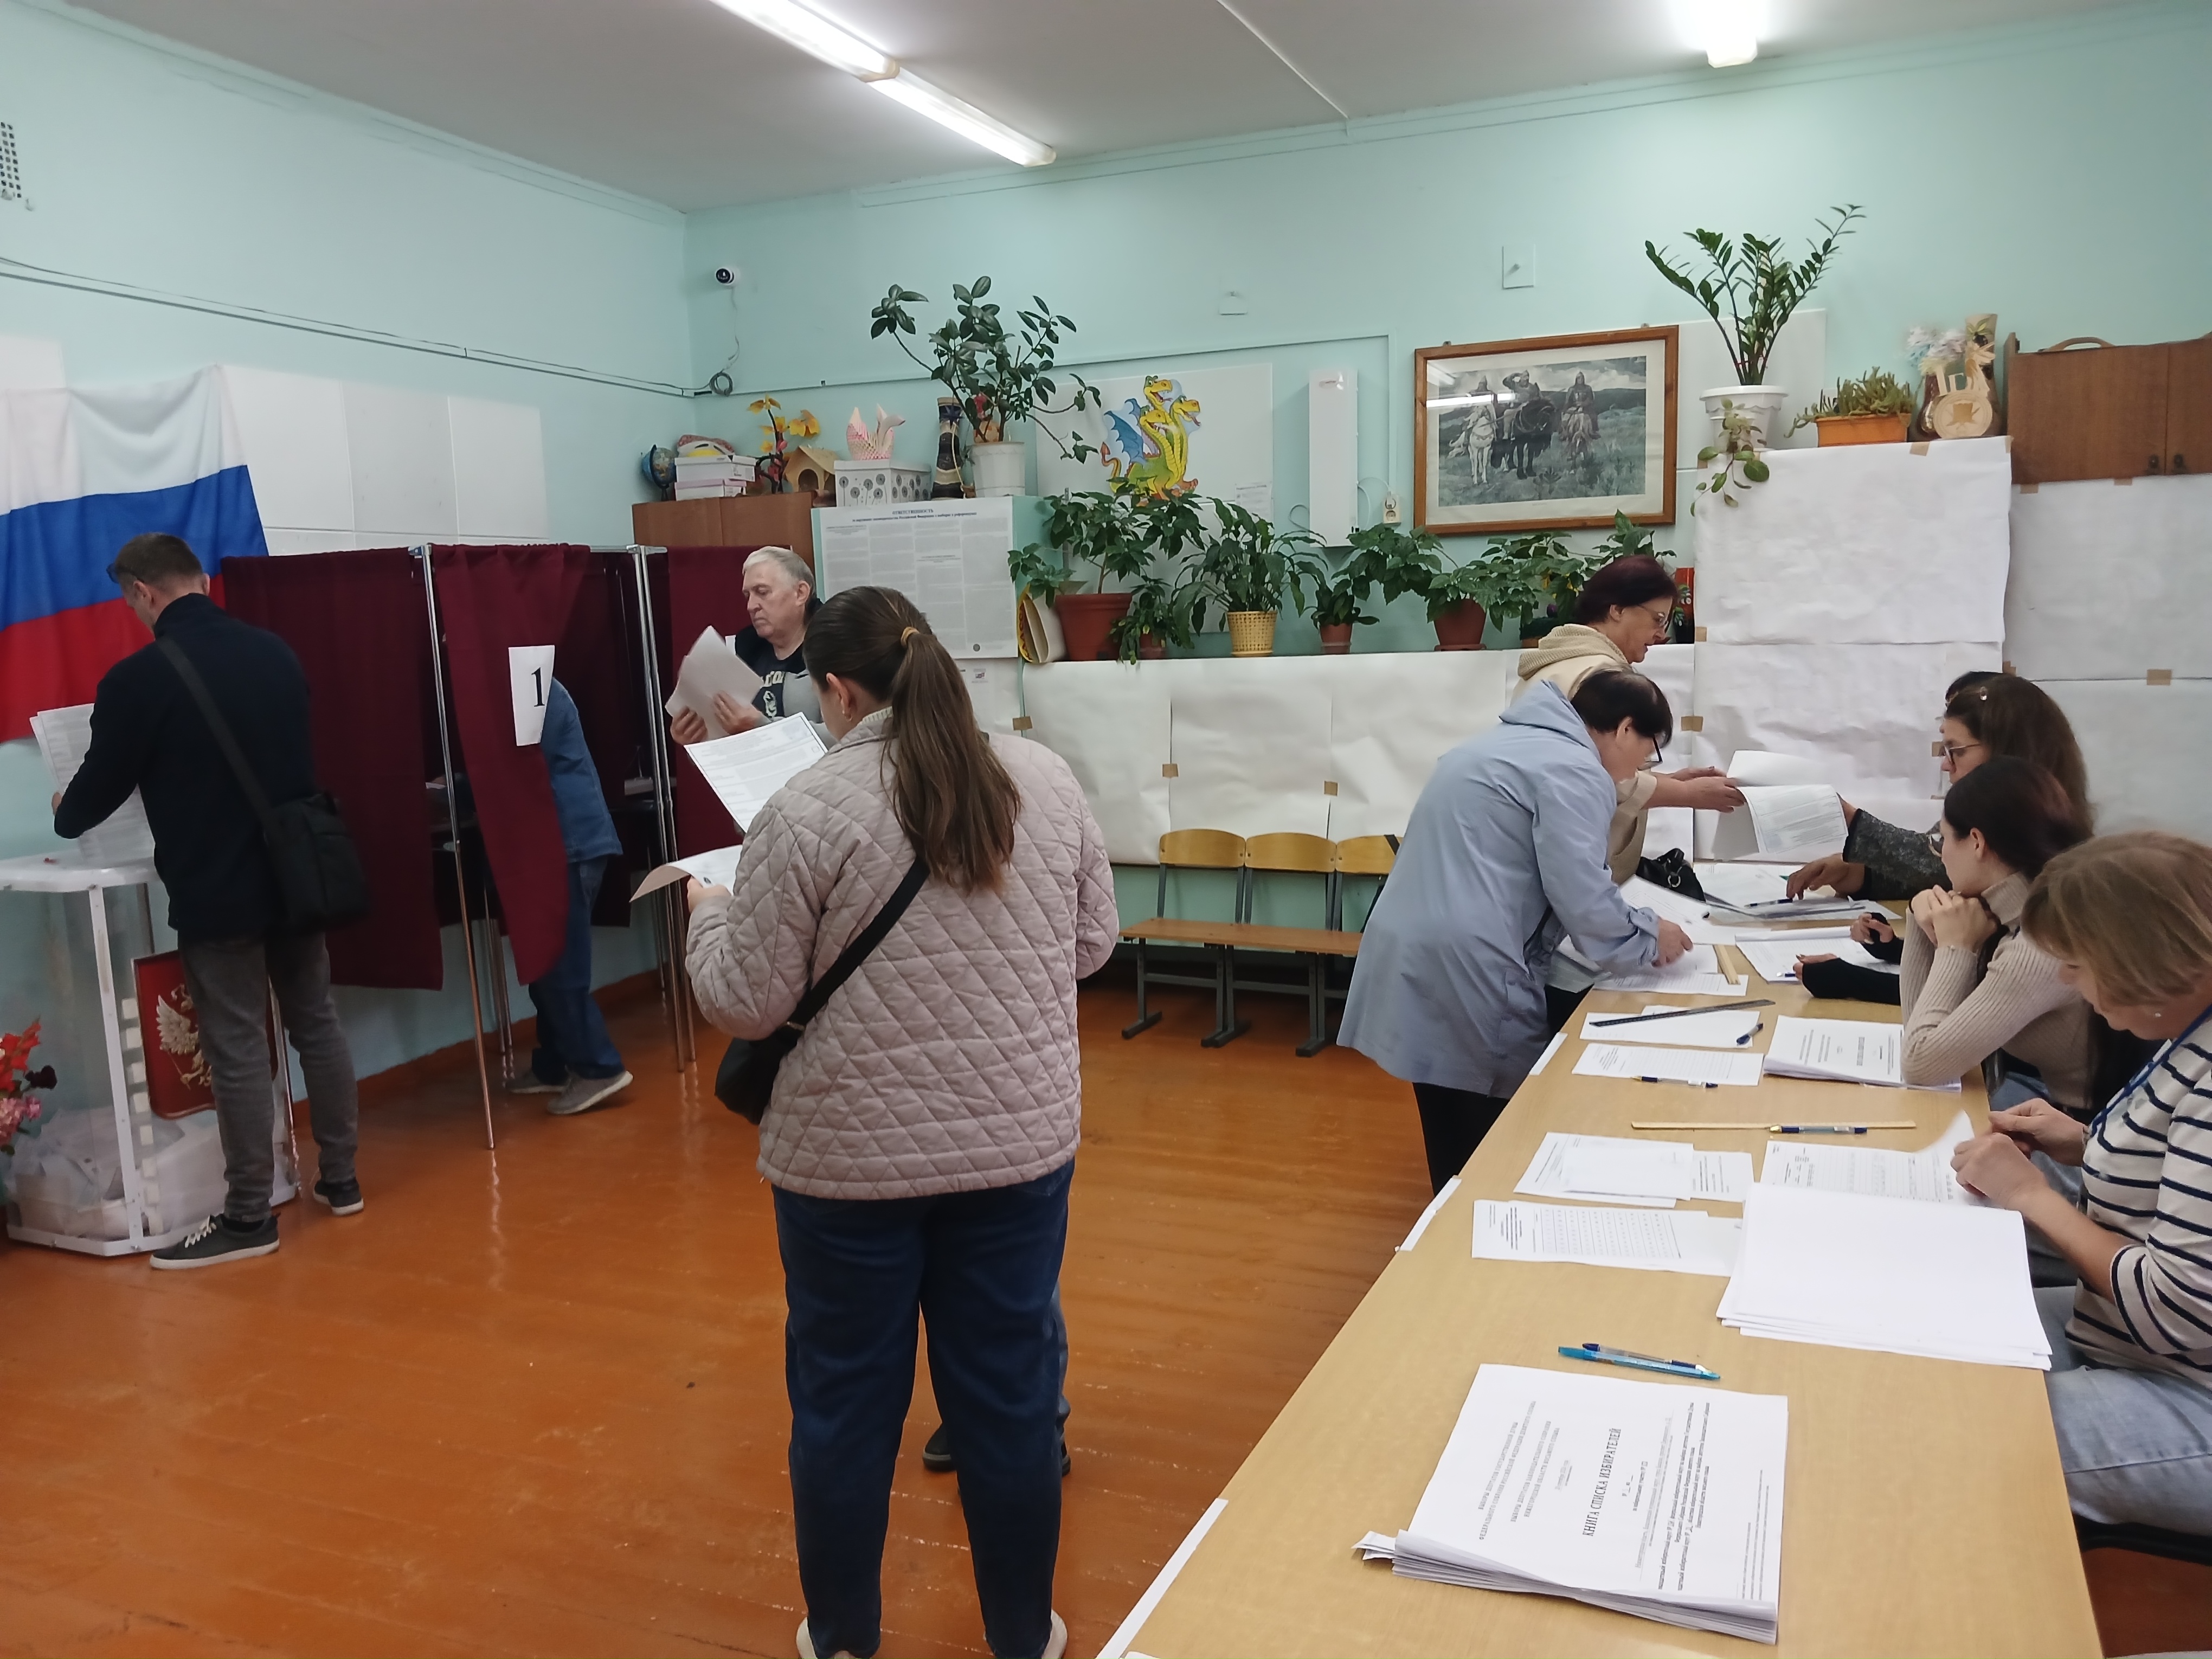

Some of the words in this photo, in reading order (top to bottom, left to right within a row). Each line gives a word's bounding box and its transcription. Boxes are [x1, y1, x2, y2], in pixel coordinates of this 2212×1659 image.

[531, 667, 545, 707] 1
[1599, 1427, 1621, 1479] ИЗБИРАТЕЛЕЙ
[1591, 1481, 1608, 1509] СПИСКА
[1582, 1511, 1600, 1537] КНИГА
